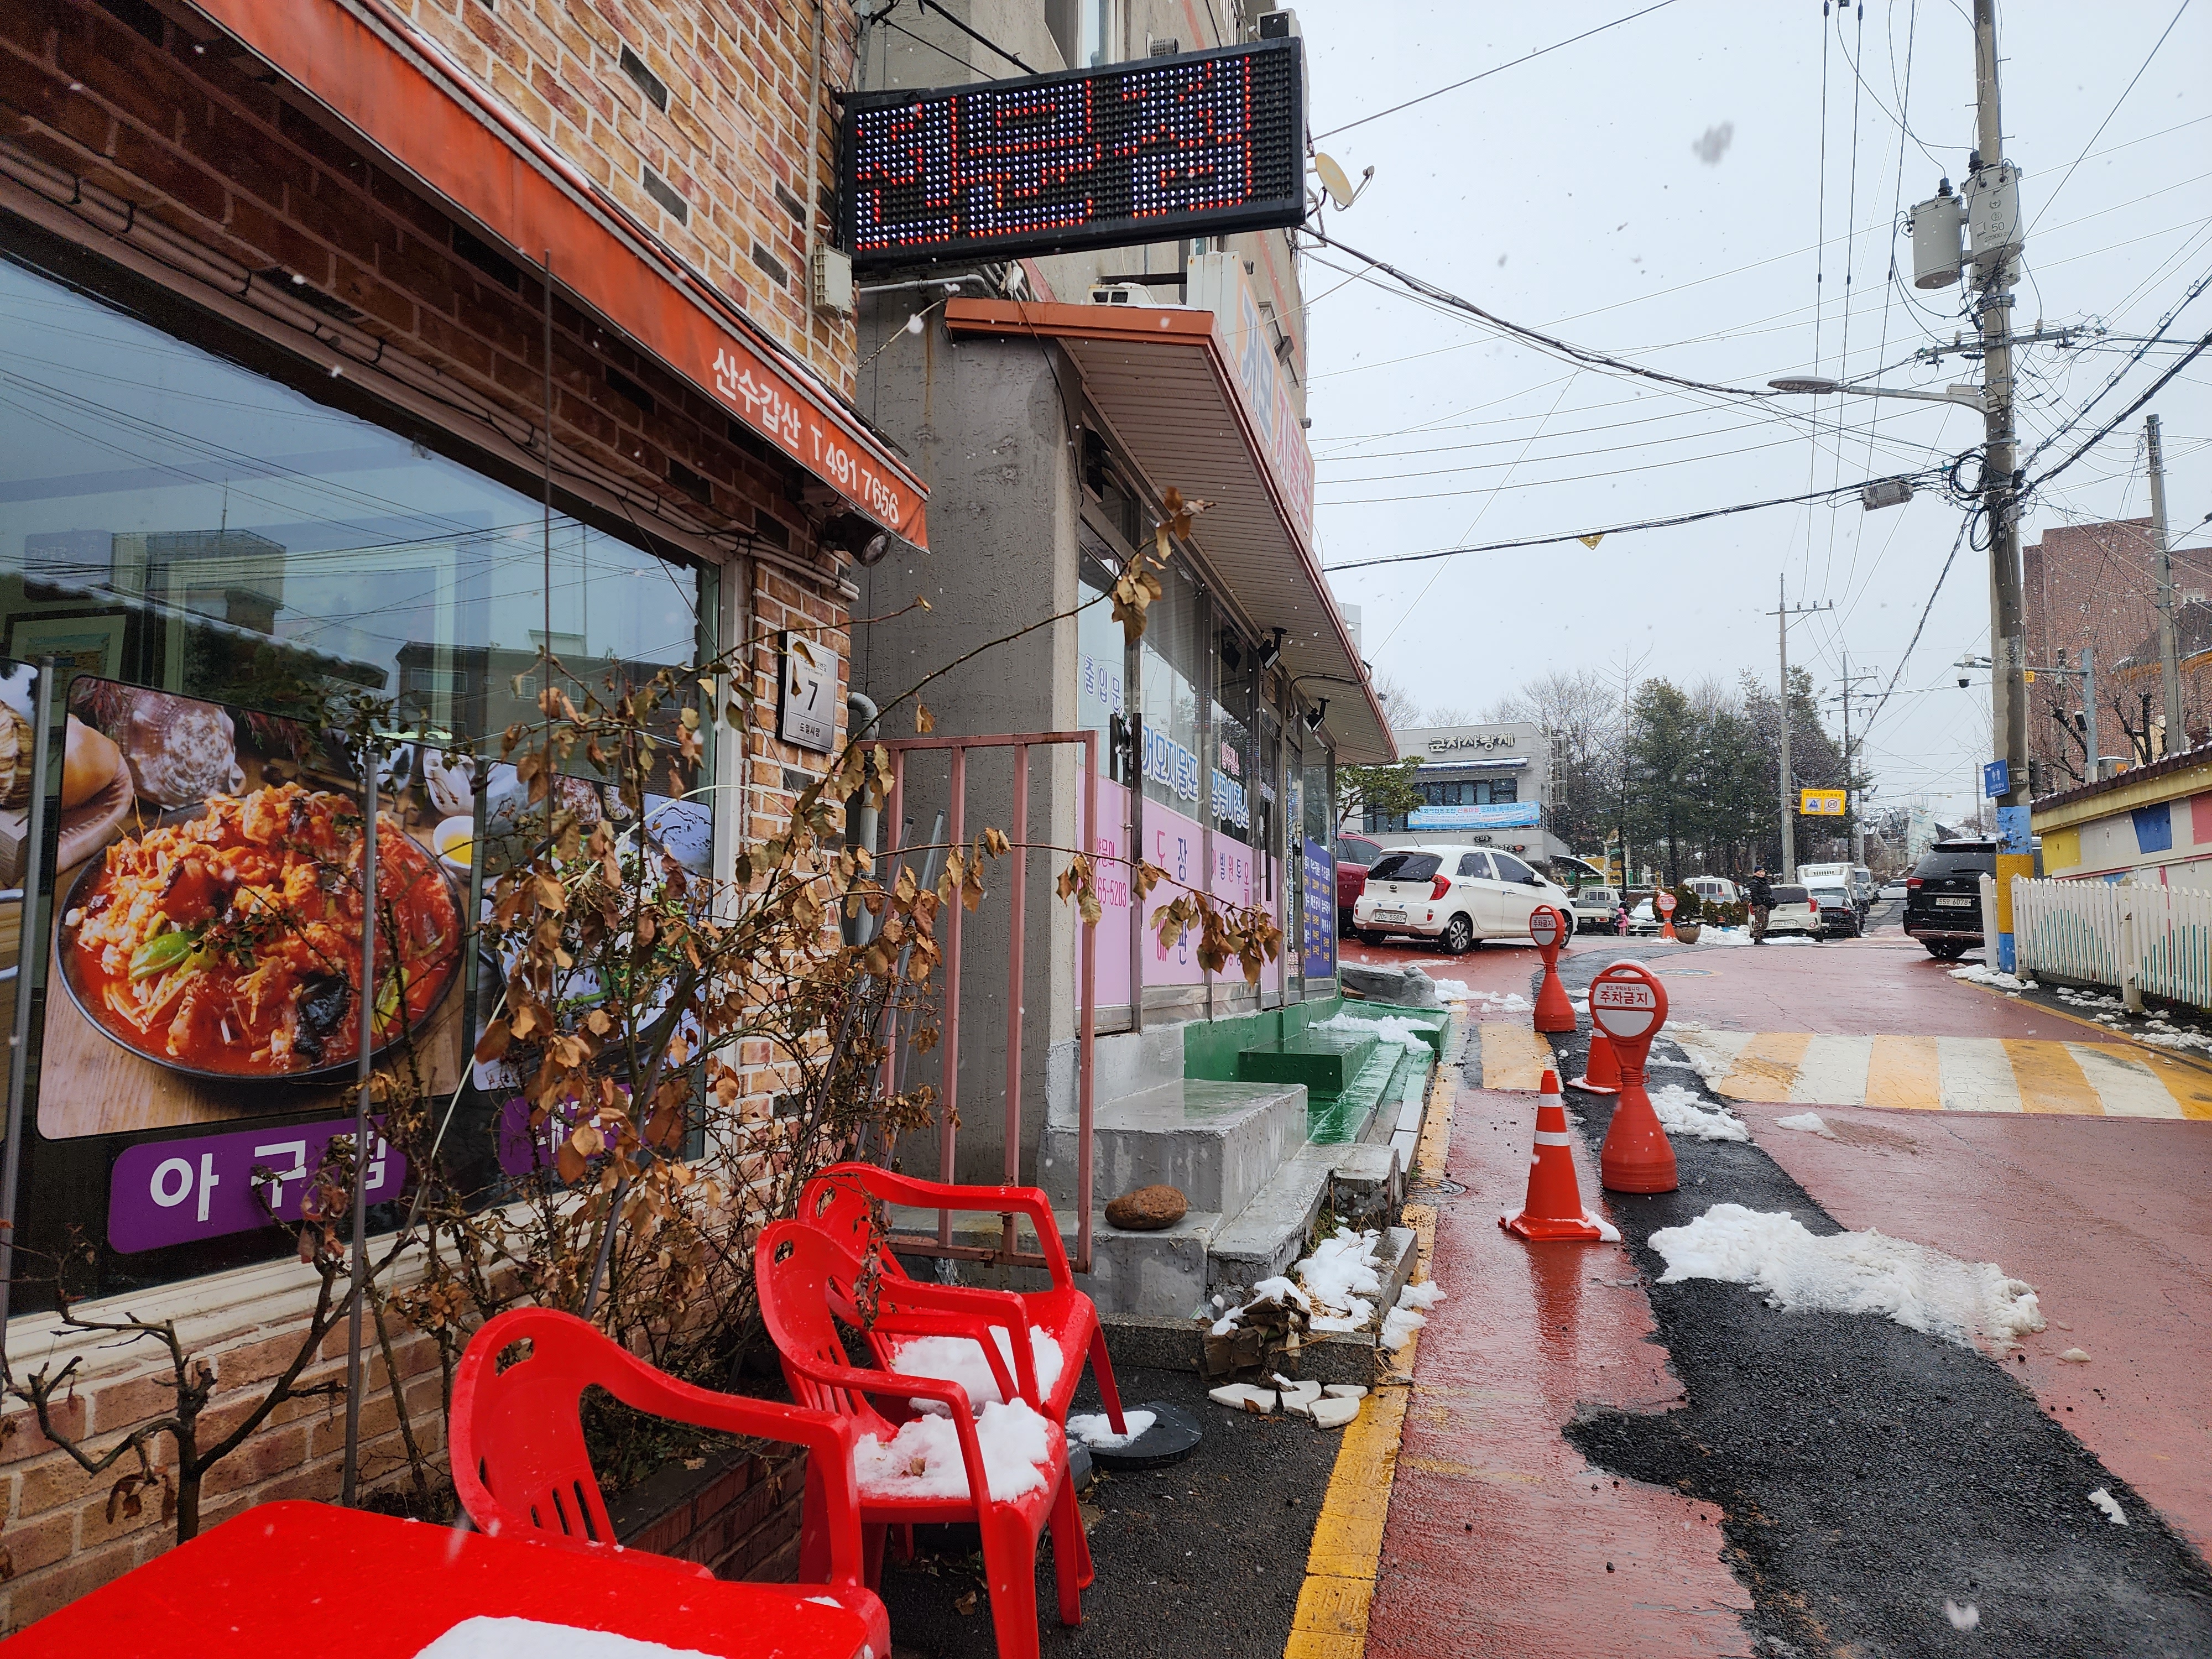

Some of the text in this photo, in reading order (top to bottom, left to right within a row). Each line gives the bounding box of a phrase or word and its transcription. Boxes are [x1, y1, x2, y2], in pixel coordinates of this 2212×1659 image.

[1991, 222, 2005, 232] 50
[713, 348, 899, 524] 산수갑산 T 491 7656
[1084, 654, 1122, 713] 출입문
[807, 679, 818, 711] 7
[800, 722, 821, 738] 도일시장
[1429, 732, 1515, 753] 군자사랑채
[1142, 724, 1199, 801] 거모지물포
[1533, 919, 1553, 928] 주차금지
[1600, 991, 1648, 1005] 주차금지
